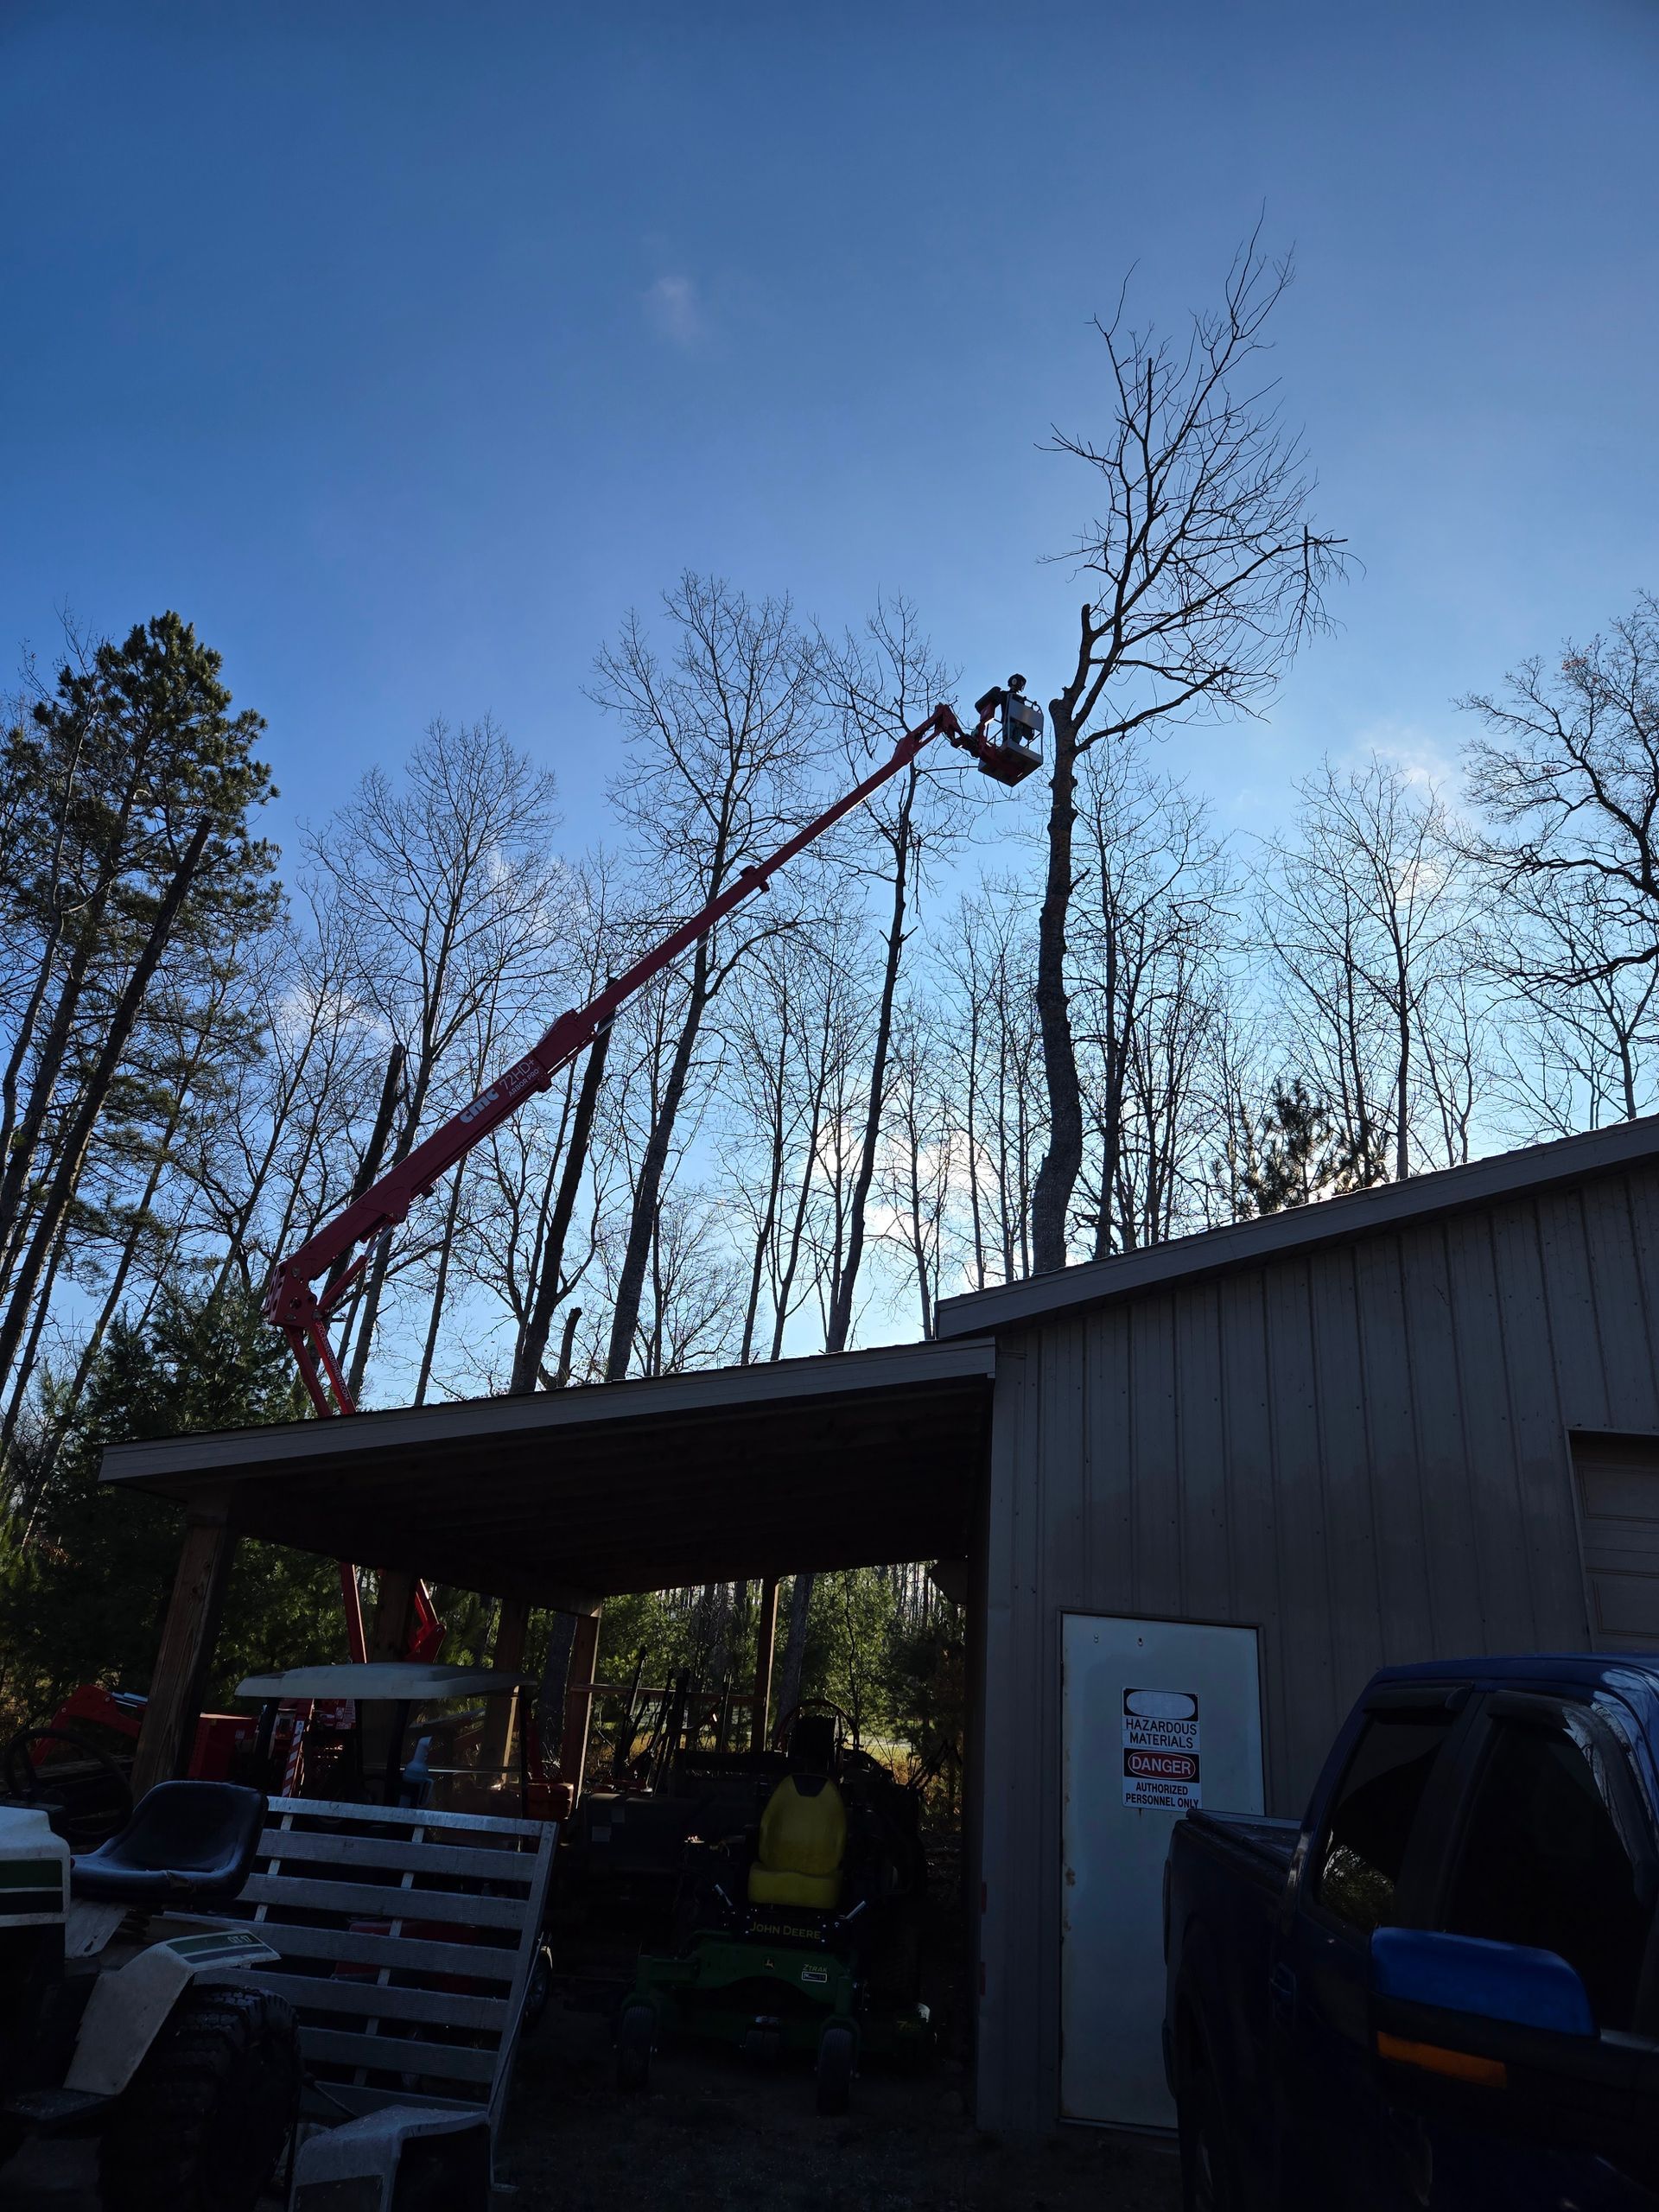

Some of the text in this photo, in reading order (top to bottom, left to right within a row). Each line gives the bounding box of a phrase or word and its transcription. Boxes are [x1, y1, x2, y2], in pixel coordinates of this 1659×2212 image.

[499, 1059, 534, 1090] 72HD+
[509, 1068, 539, 1096] ARBOR PRO
[1126, 1718, 1197, 1736] HAZARDOUS
[1129, 1732, 1193, 1749] MATERIALS
[1132, 1756, 1192, 1775] DANGER
[1135, 1782, 1188, 1796] AUTHORIZED
[1126, 1793, 1199, 1810] PERSONNEL ONLY
[750, 1921, 822, 1940] JOHN DEERE
